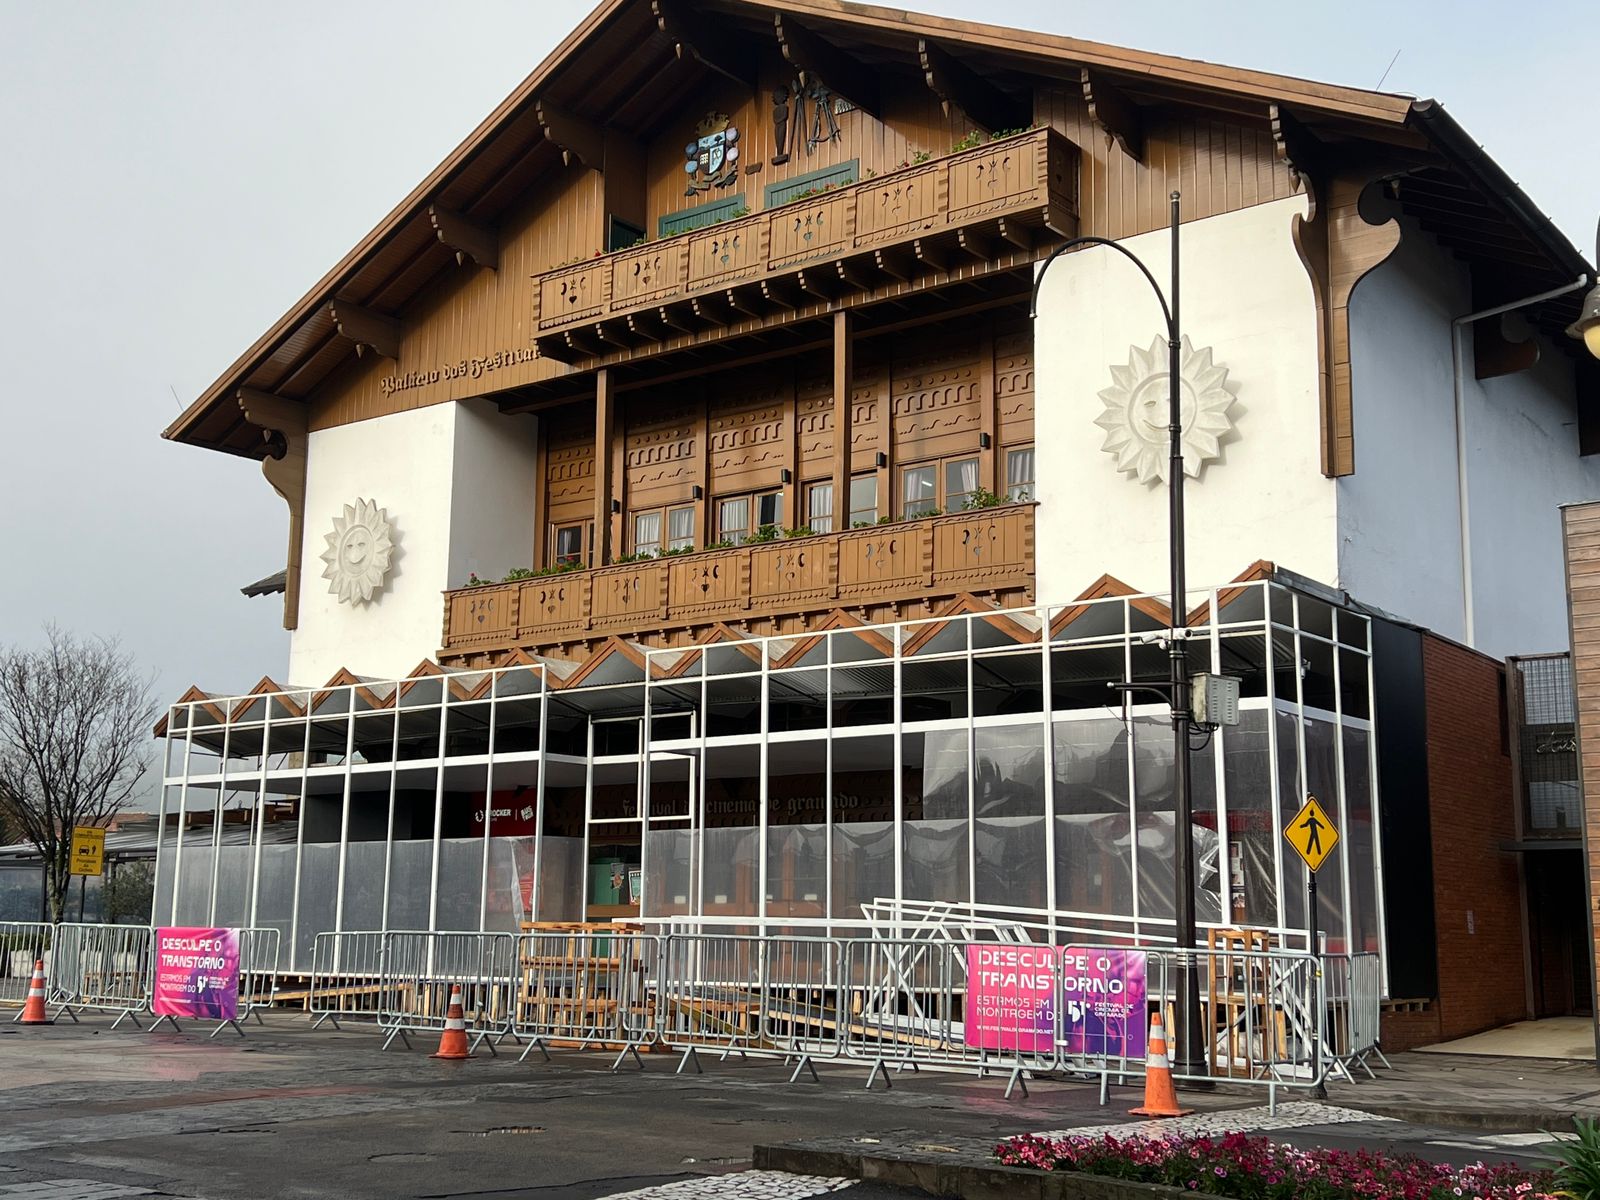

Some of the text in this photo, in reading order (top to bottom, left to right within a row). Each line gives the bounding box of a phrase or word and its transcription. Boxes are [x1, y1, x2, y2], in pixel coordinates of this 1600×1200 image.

[442, 360, 467, 380] dos
[162, 937, 222, 953] DESCULPE O
[161, 954, 225, 970] TRANSTORNO
[978, 950, 1111, 972] DESCULPE O
[160, 973, 192, 984] ESTAMOS EM
[160, 982, 196, 993] MONTAGEM DO
[976, 994, 1050, 1010] ESTAMOS EM
[976, 1006, 1043, 1021] MONTAGEM
